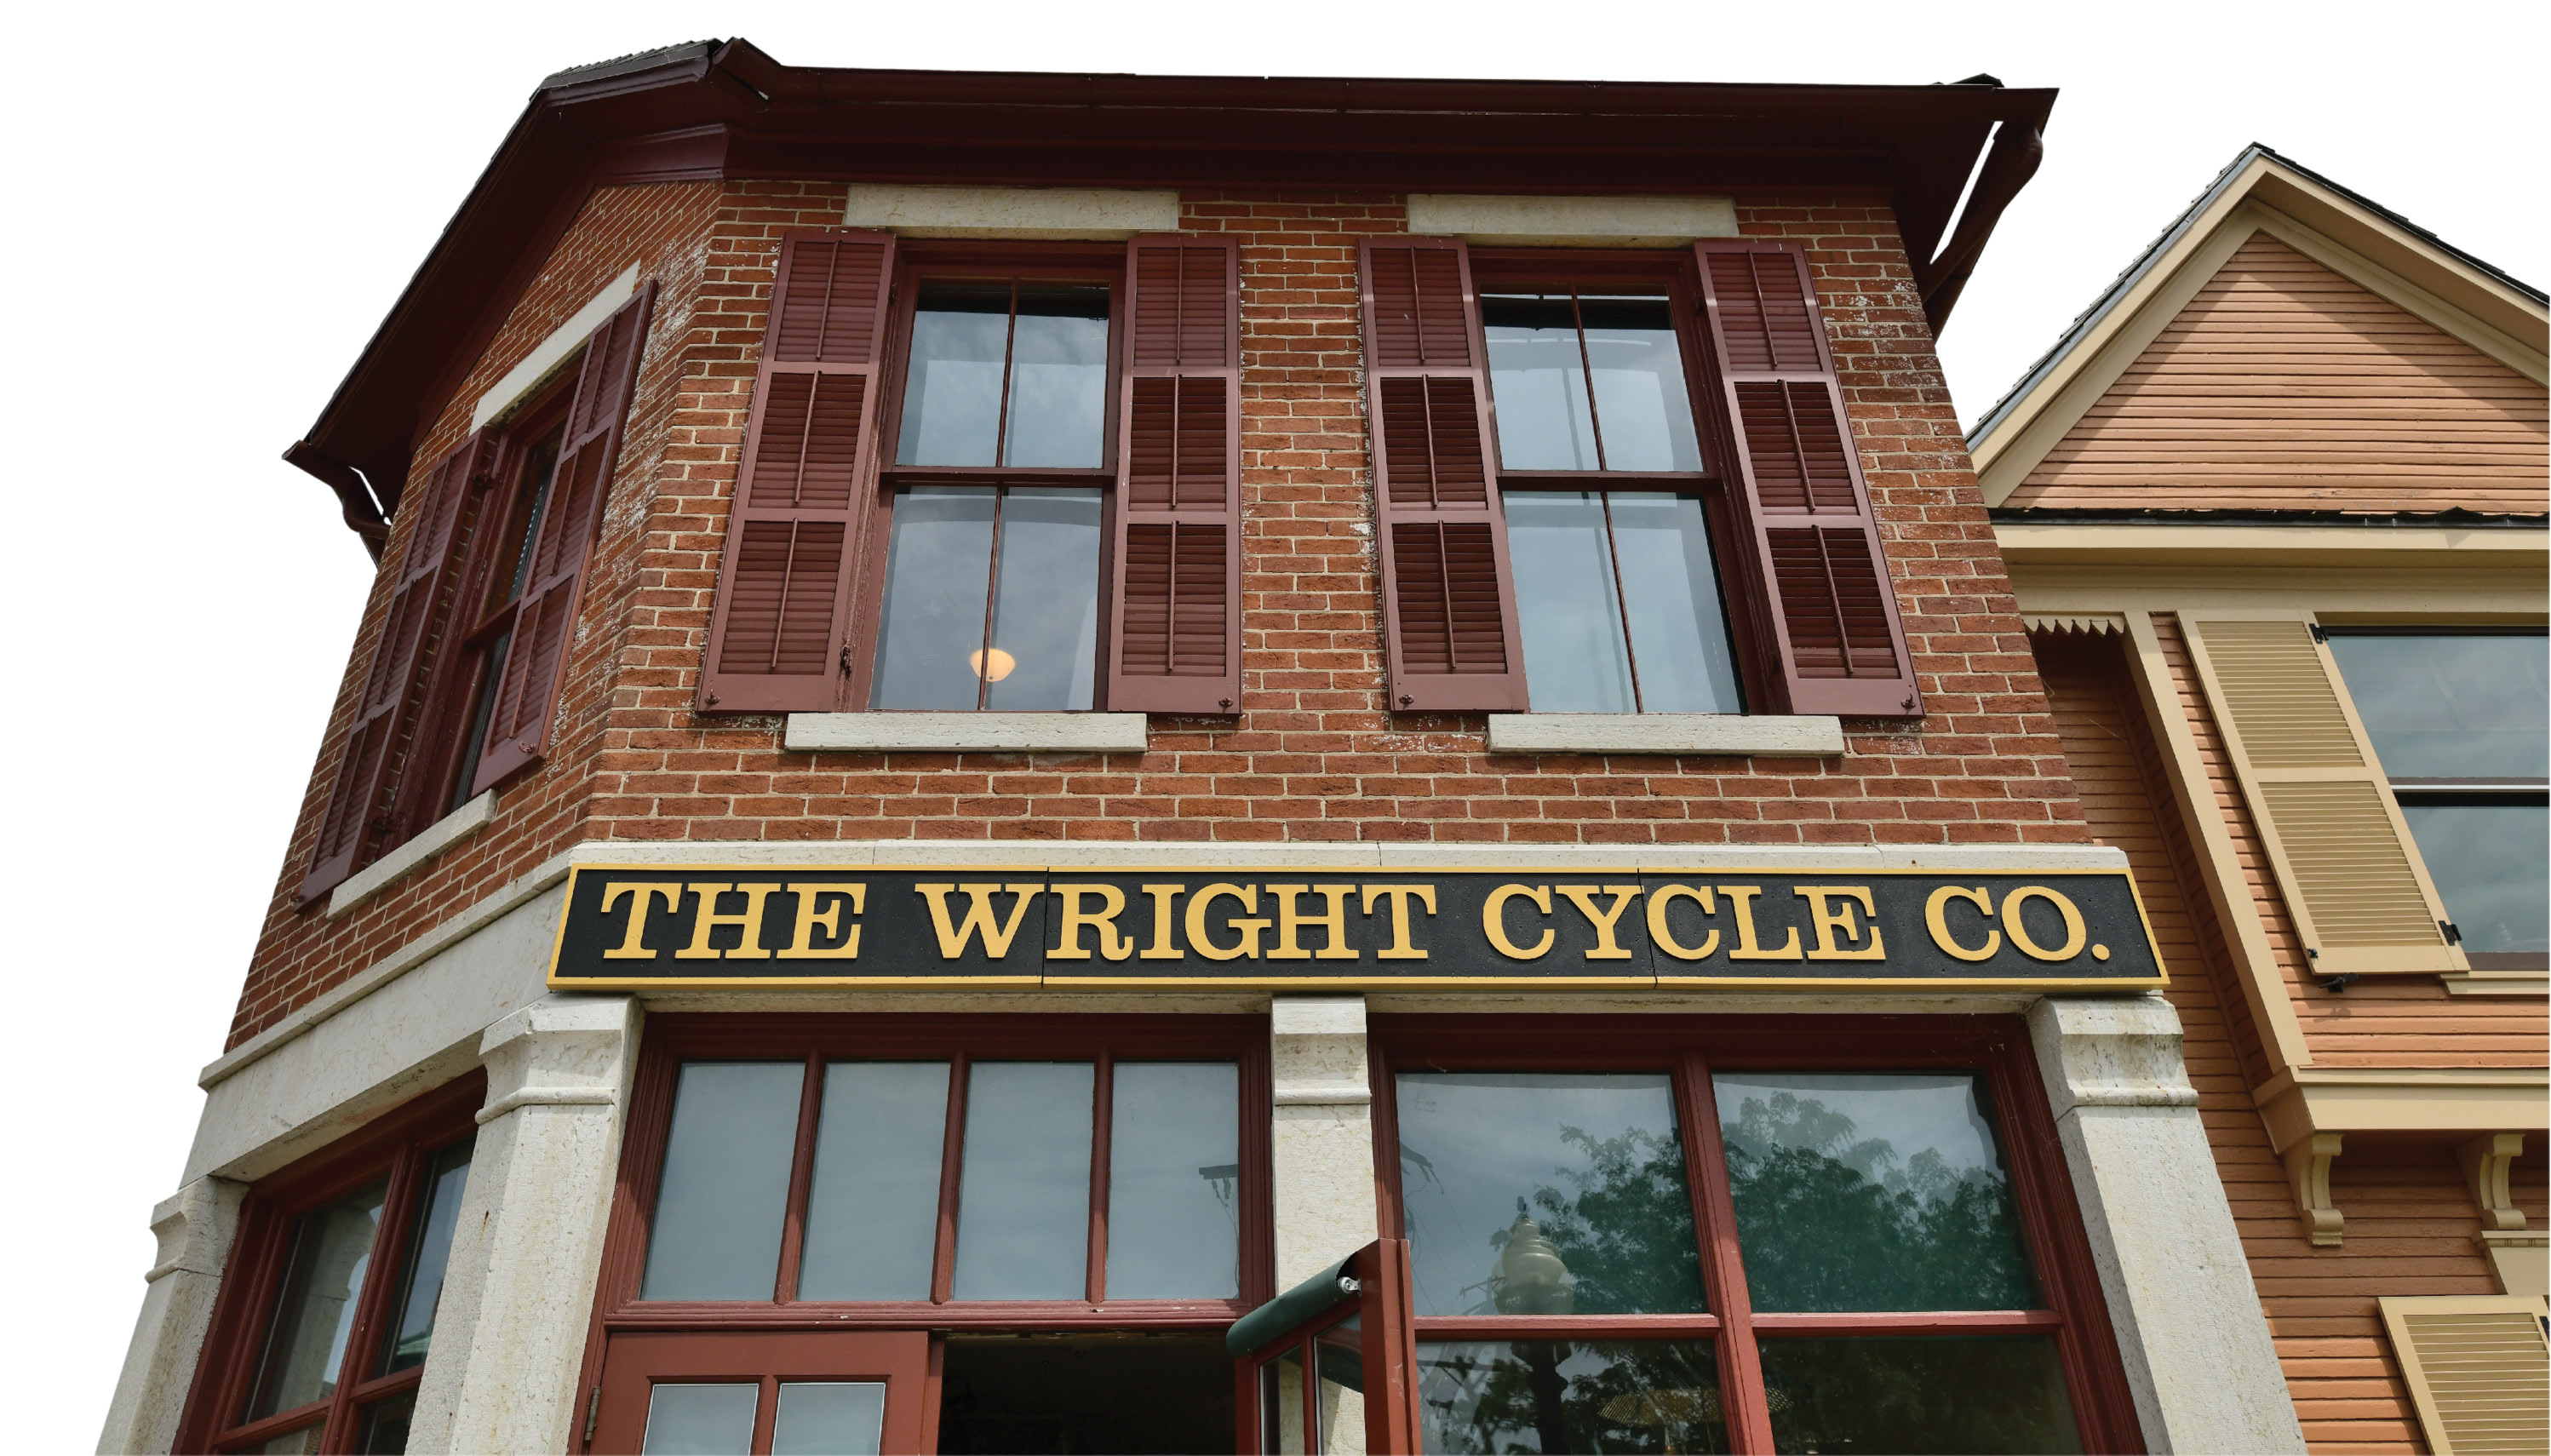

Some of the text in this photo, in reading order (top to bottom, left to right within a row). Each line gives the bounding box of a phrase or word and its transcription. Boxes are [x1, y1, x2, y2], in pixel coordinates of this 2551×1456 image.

[600, 881, 2110, 961] THE WRIGHT CYCLE CO.
